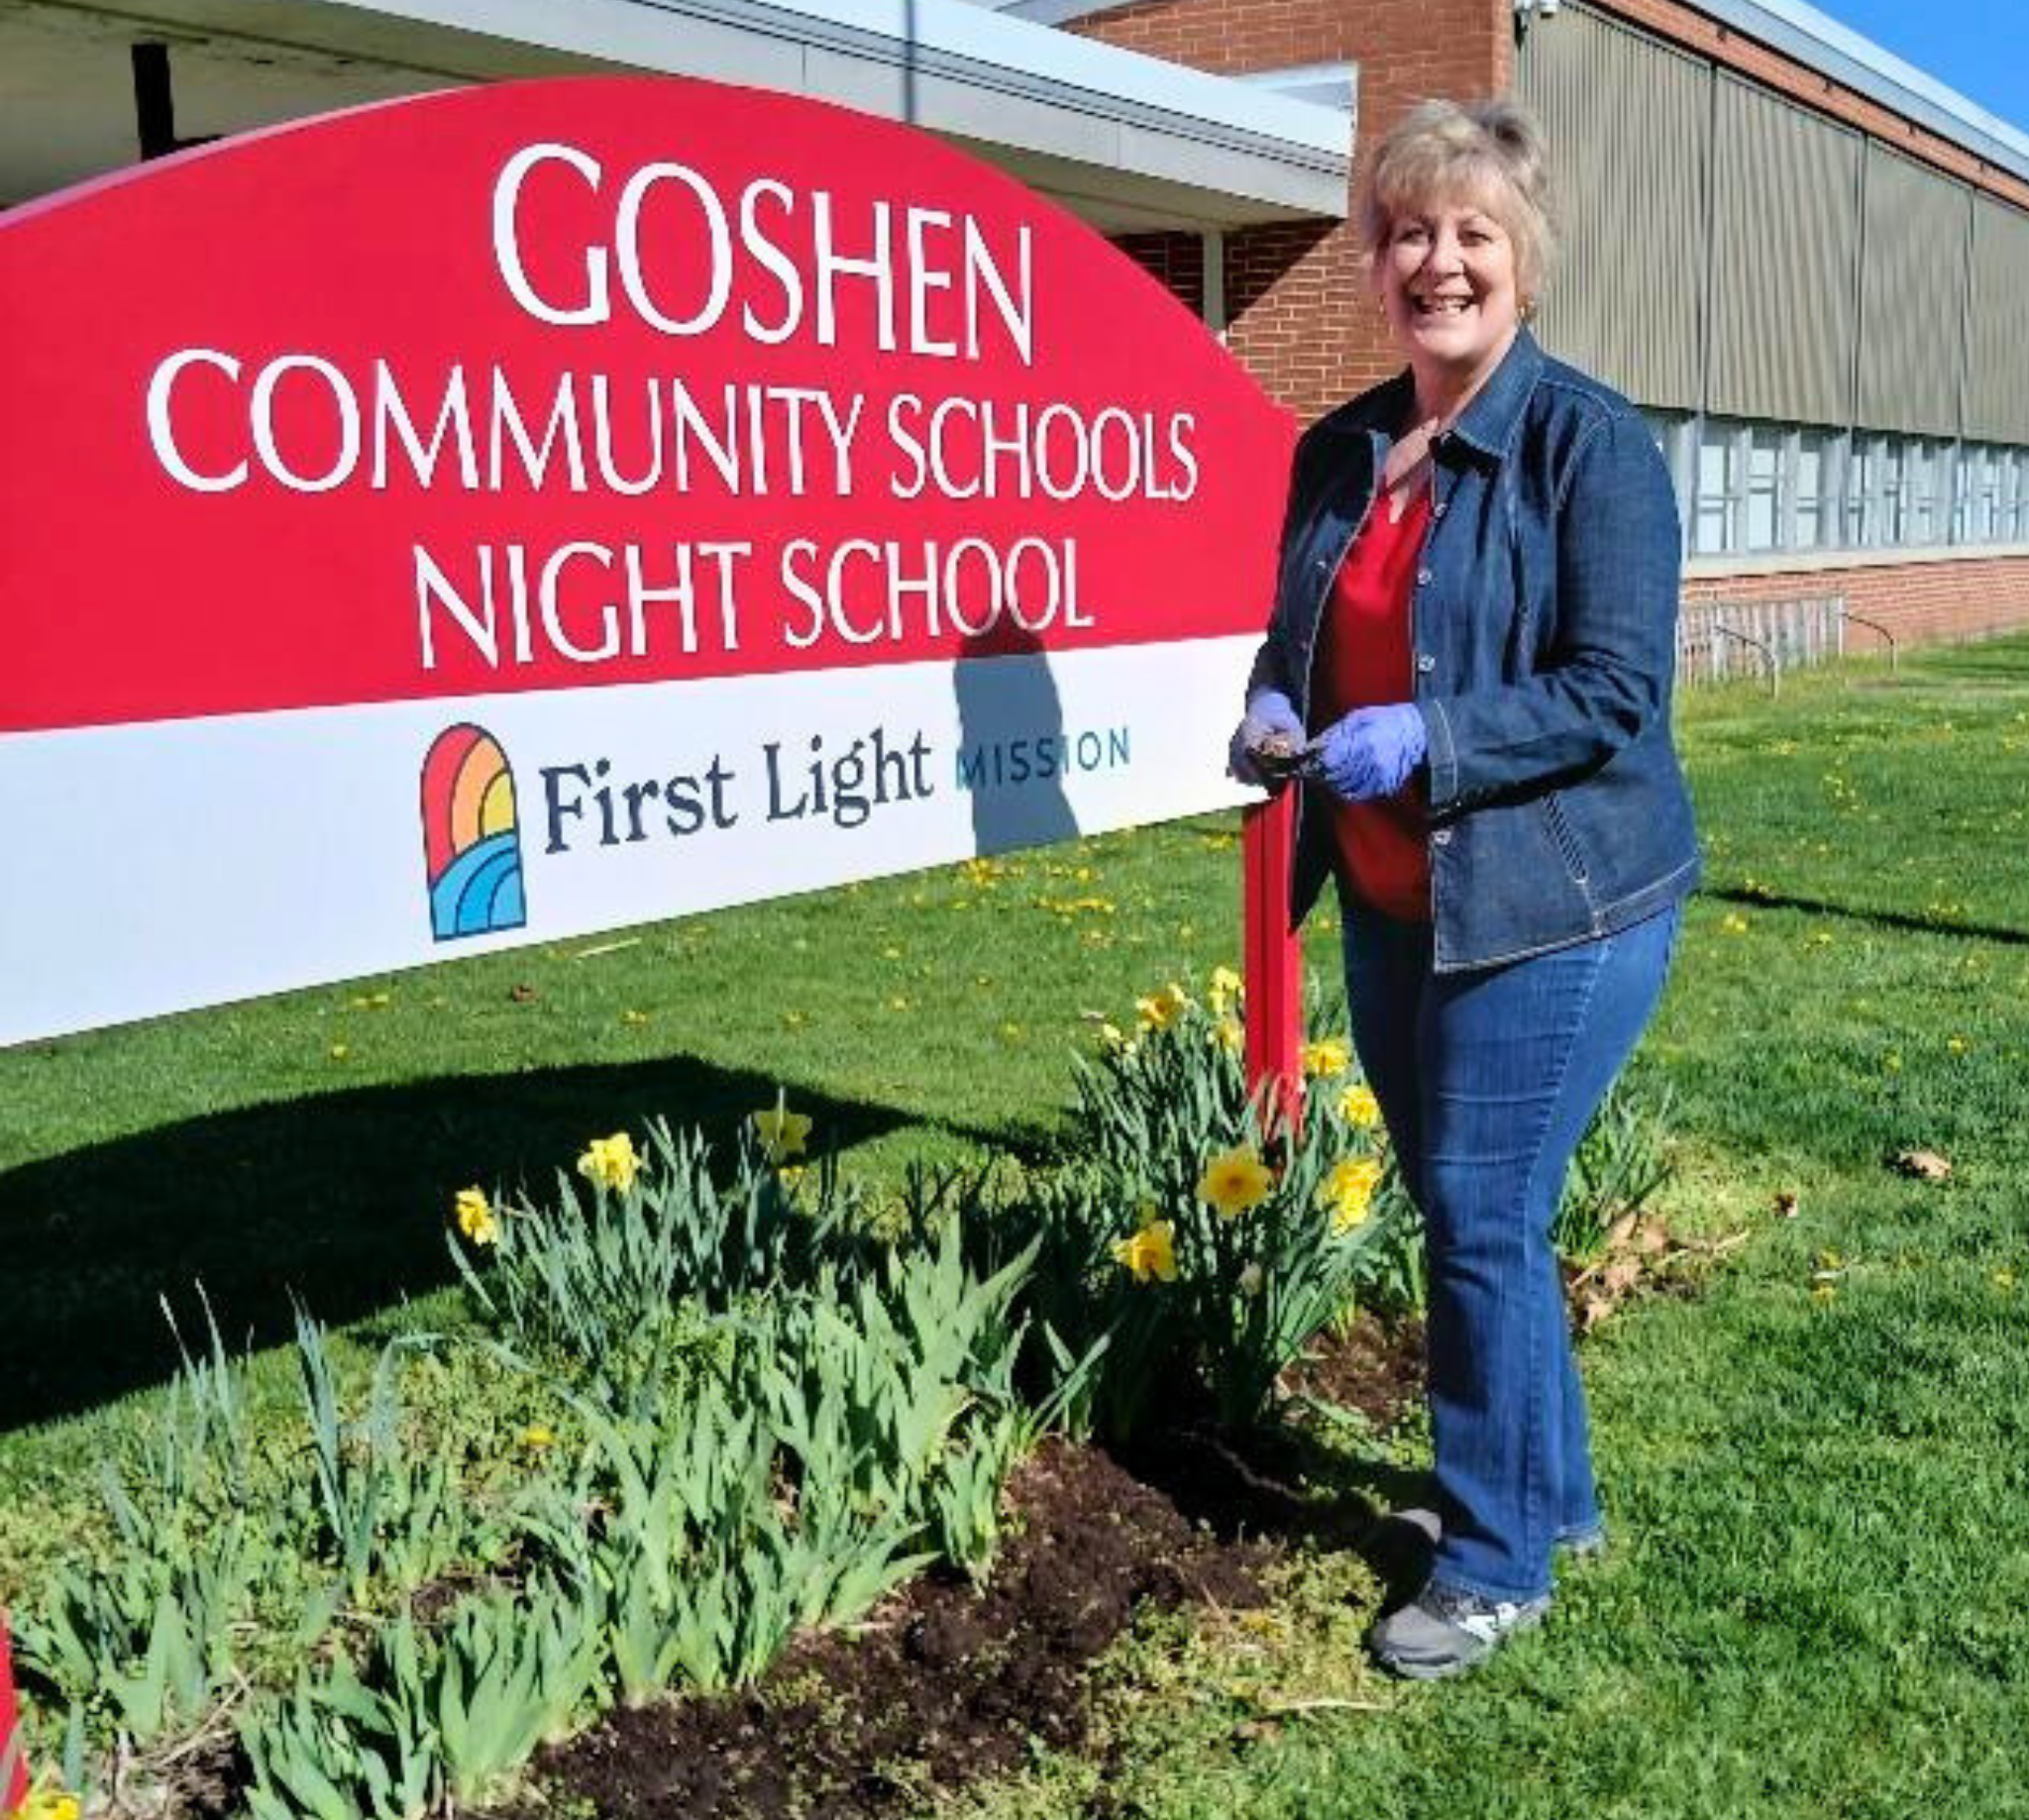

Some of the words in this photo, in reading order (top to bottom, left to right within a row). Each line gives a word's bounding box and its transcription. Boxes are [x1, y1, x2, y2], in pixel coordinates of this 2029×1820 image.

[493, 143, 1031, 366] GOSHEN
[148, 348, 863, 495] COMMUNITY
[889, 394, 1198, 501] SCHOOLS
[414, 541, 751, 669] NIGHT
[782, 538, 1095, 648] SCHOOL
[539, 754, 738, 854] First
[763, 728, 933, 826] Light
[956, 726, 1130, 791] MISSION
